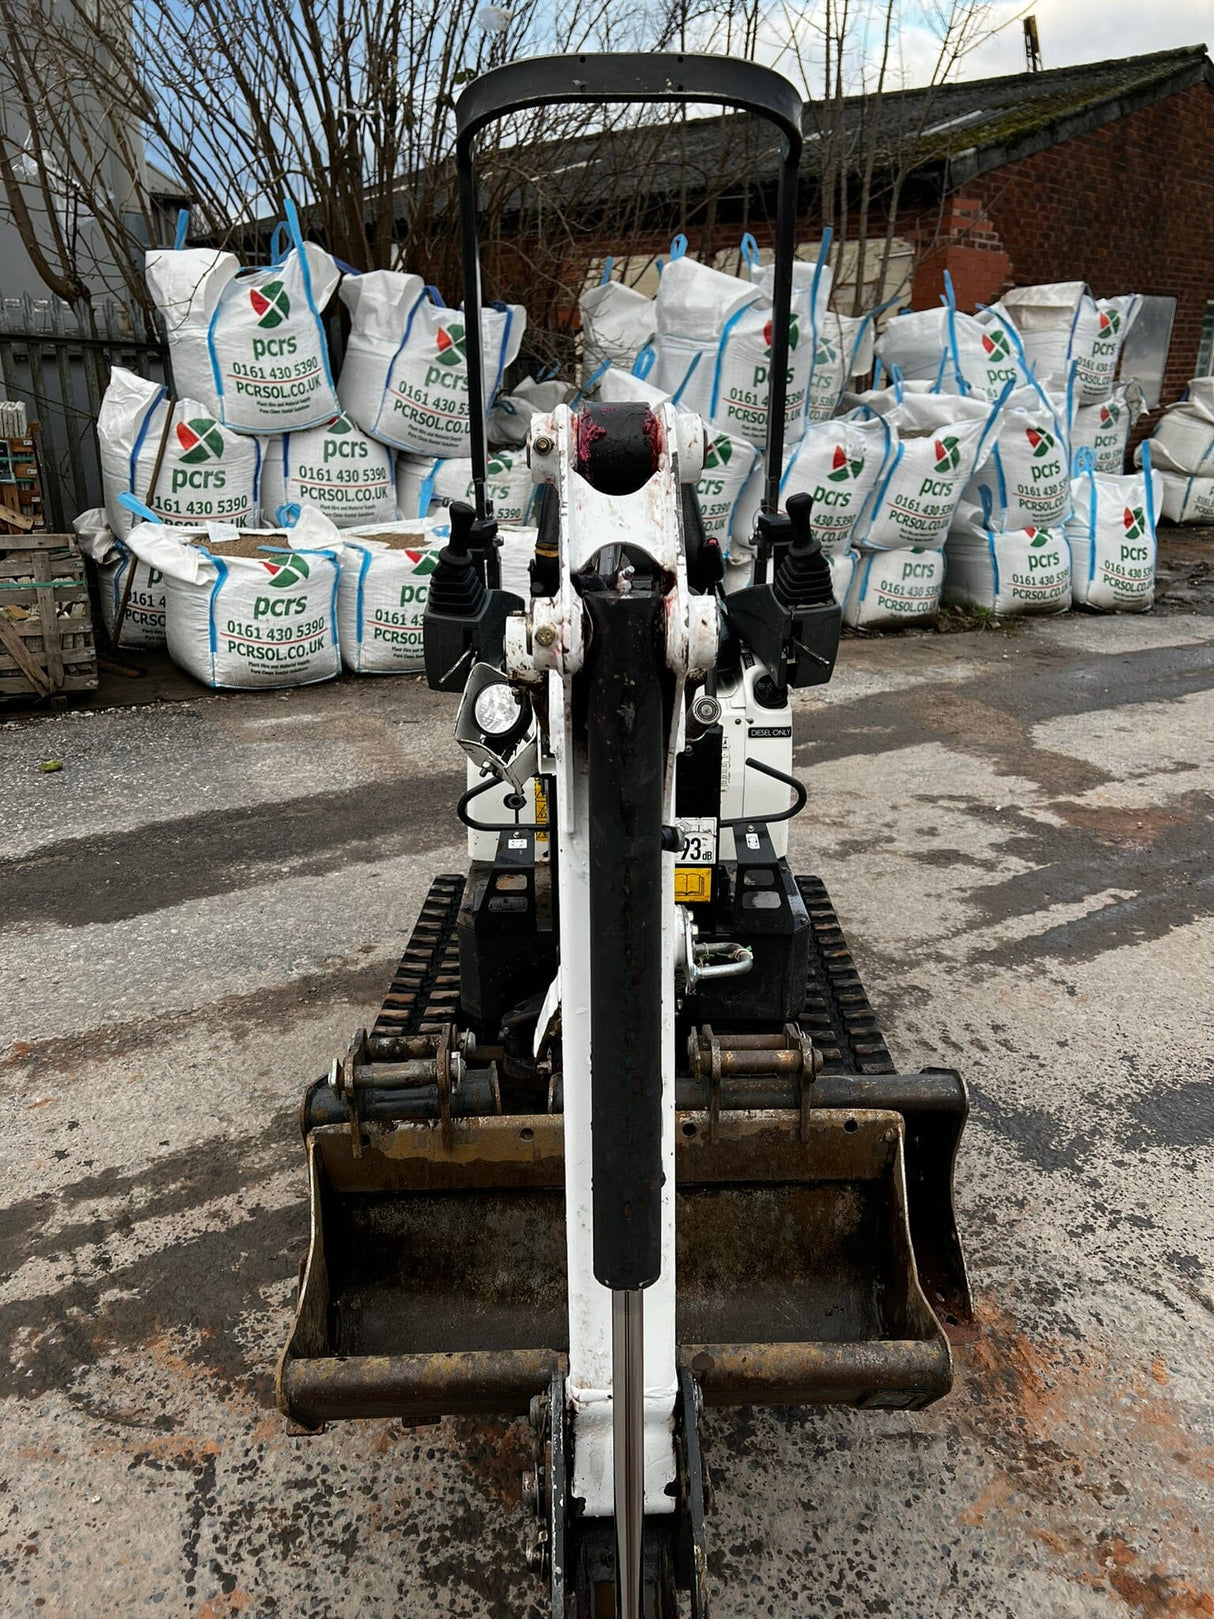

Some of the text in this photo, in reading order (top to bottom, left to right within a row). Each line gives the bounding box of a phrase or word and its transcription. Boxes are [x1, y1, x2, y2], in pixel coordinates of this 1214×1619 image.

[253, 336, 297, 360] pcrs
[1092, 341, 1115, 357] pcrs
[233, 356, 317, 379] 0161 430 5390
[987, 368, 1016, 385] pcrs
[236, 375, 321, 398] PCRSOL.CO.UK
[400, 381, 470, 415] 0161 430 53
[730, 388, 757, 405] 0161
[394, 399, 470, 433] PCRSOL.CO.U
[1095, 434, 1118, 448] pcrs
[324, 440, 368, 463] pcrs
[299, 465, 386, 482] 0161 430 5390
[1031, 460, 1060, 482] pcrs
[172, 469, 226, 493] pcrs
[696, 479, 724, 495] crs
[919, 478, 953, 496] pcrs
[300, 485, 388, 501] PCRSOL.CO.UK
[1018, 484, 1041, 496] 0161
[155, 495, 247, 514] 161 430 5390
[497, 508, 521, 518] 5390
[895, 494, 920, 512] 0161
[922, 504, 940, 515] 430
[814, 513, 833, 525] 430
[1028, 552, 1059, 571] pcrs
[1121, 545, 1147, 561] pcrs
[902, 563, 935, 580] pcrs
[1105, 560, 1125, 575] 0161
[1129, 569, 1142, 577] 430
[881, 580, 904, 595] 0161
[908, 587, 923, 596] 430
[1013, 574, 1036, 585] 0161
[1039, 575, 1054, 585] 430
[131, 591, 154, 607] 161
[400, 585, 427, 607] pc
[254, 595, 307, 620] pcrs
[375, 609, 406, 625] 0161
[227, 617, 324, 641] 0161 430 5390
[374, 627, 424, 644] PCRSOL
[228, 636, 324, 660] PCRSOL.CO.UK
[751, 728, 790, 736] DIESEL ONLY
[702, 851, 712, 860] dB
